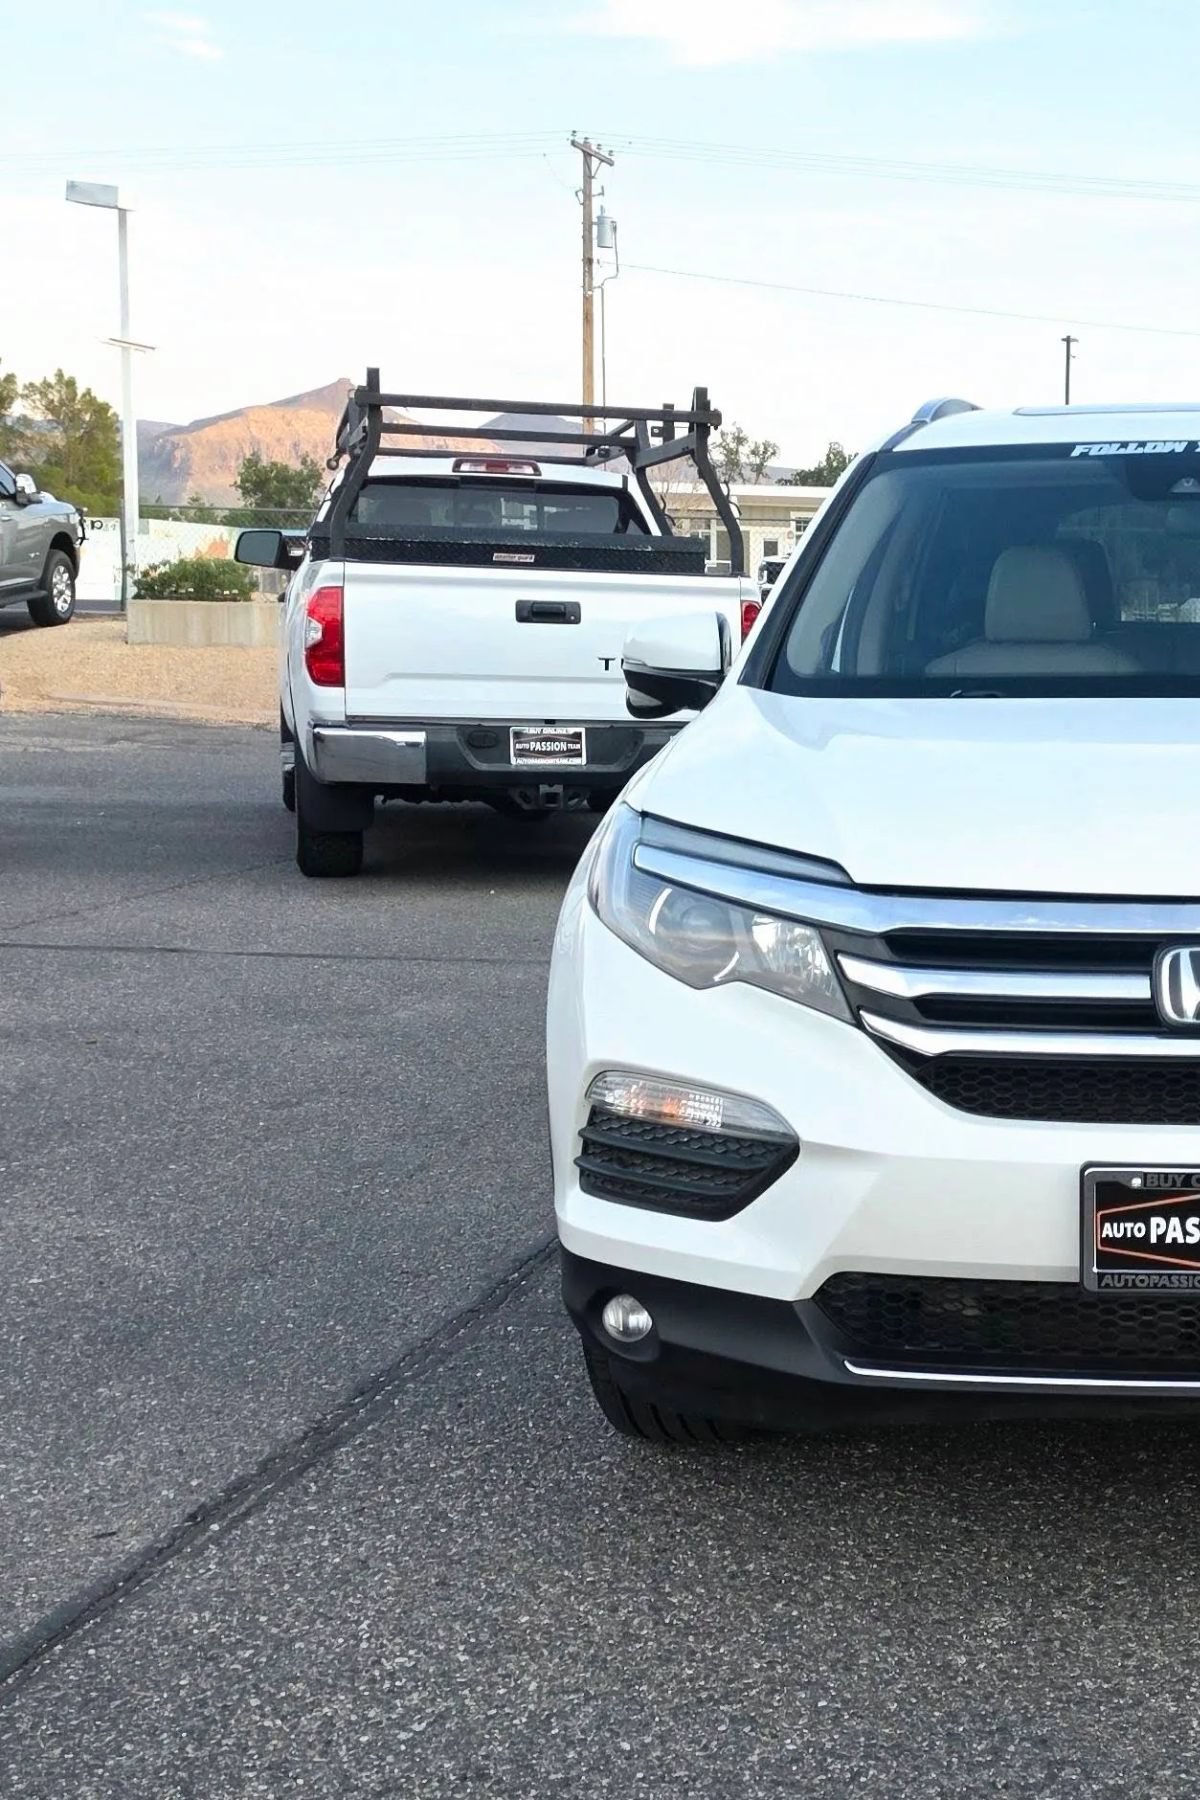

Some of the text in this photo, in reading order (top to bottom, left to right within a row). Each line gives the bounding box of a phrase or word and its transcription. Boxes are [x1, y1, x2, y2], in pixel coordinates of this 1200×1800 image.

[1070, 441, 1188, 457] FOLLOW
[529, 741, 567, 752] PASSION
[1146, 1173, 1186, 1188] BUY
[1101, 1222, 1146, 1238] AUTO
